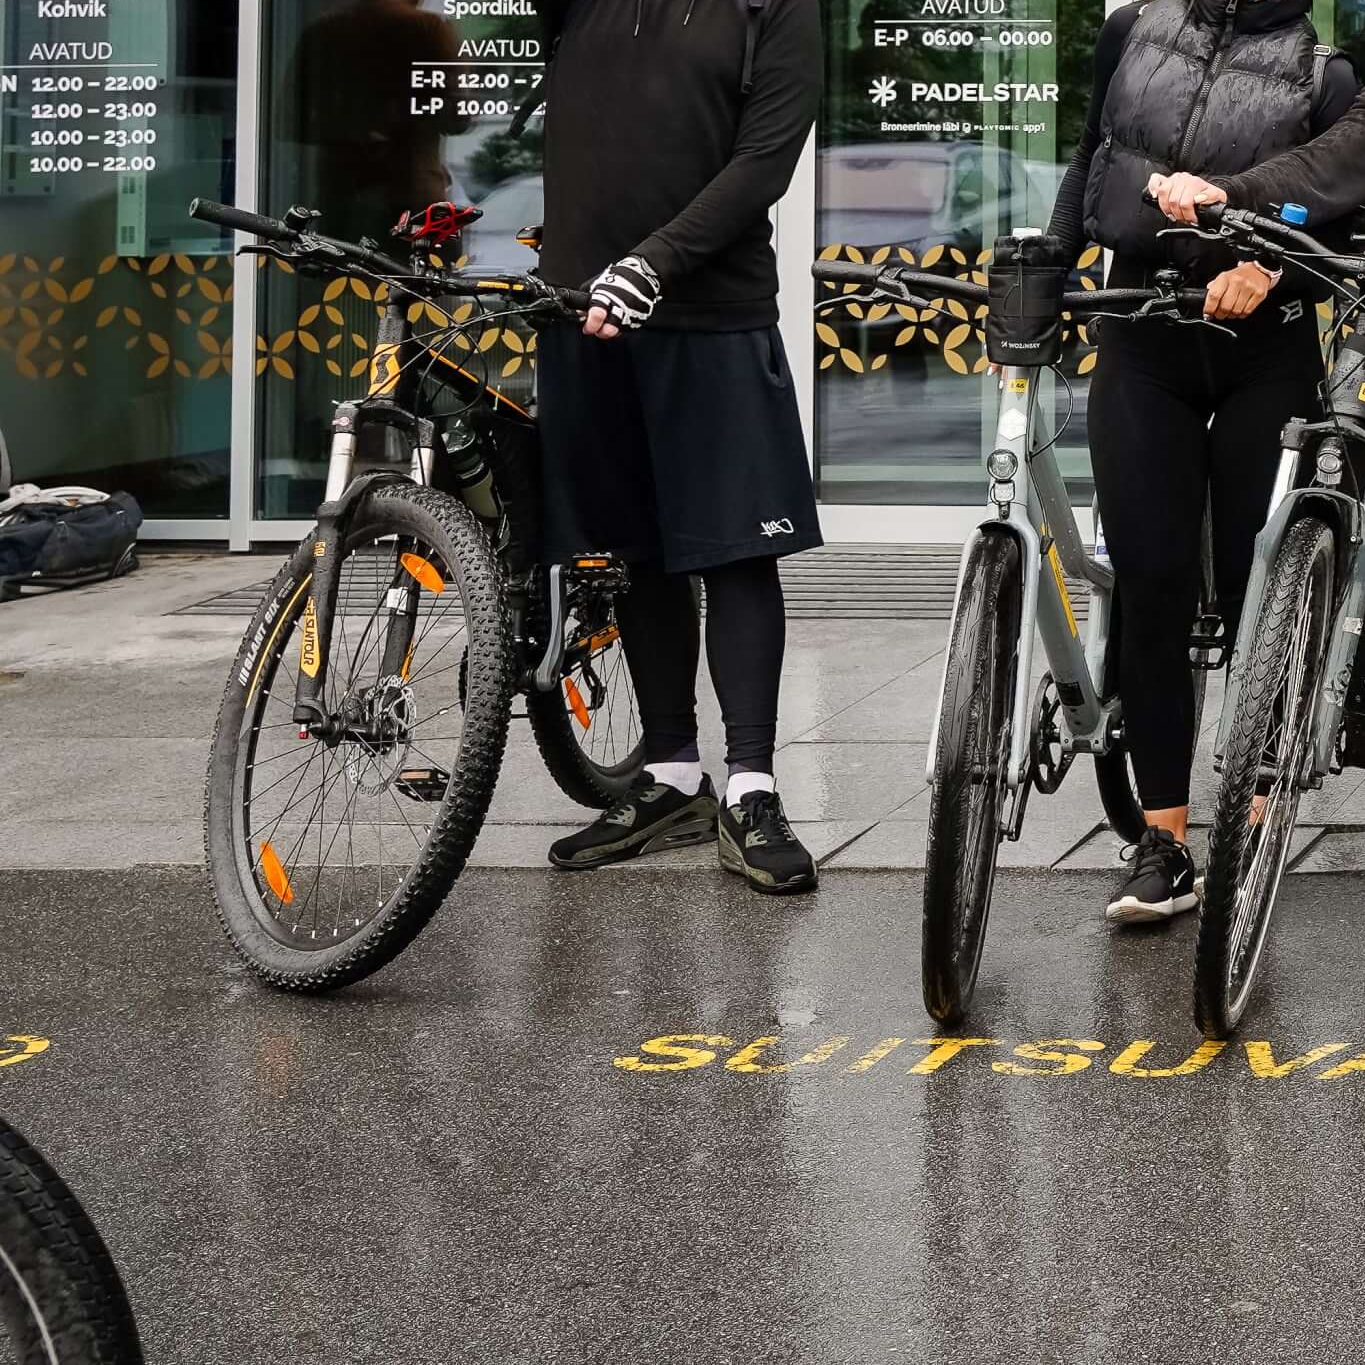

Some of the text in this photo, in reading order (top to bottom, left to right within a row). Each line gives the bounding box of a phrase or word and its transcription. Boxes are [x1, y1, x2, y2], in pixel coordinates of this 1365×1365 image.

[38, 0, 106, 18] Kohvik
[874, 29, 908, 46] E-P
[922, 29, 973, 46] 06.00
[999, 30, 1052, 46] 00.00
[29, 42, 113, 60] AVATUD
[457, 40, 540, 57] AVATUD
[31, 76, 83, 92] 12.00
[104, 75, 157, 92] 22.00
[411, 70, 446, 88] E-R
[457, 74, 509, 88] 12.00
[911, 84, 1059, 102] PADELSTAR
[31, 104, 83, 119] 12.00
[104, 102, 156, 119] 23.00
[410, 97, 508, 115] L-P 10.00
[31, 130, 83, 146] 10.00
[103, 129, 156, 147] 23.00
[30, 157, 82, 173] 10.00
[103, 156, 155, 172] 22.00
